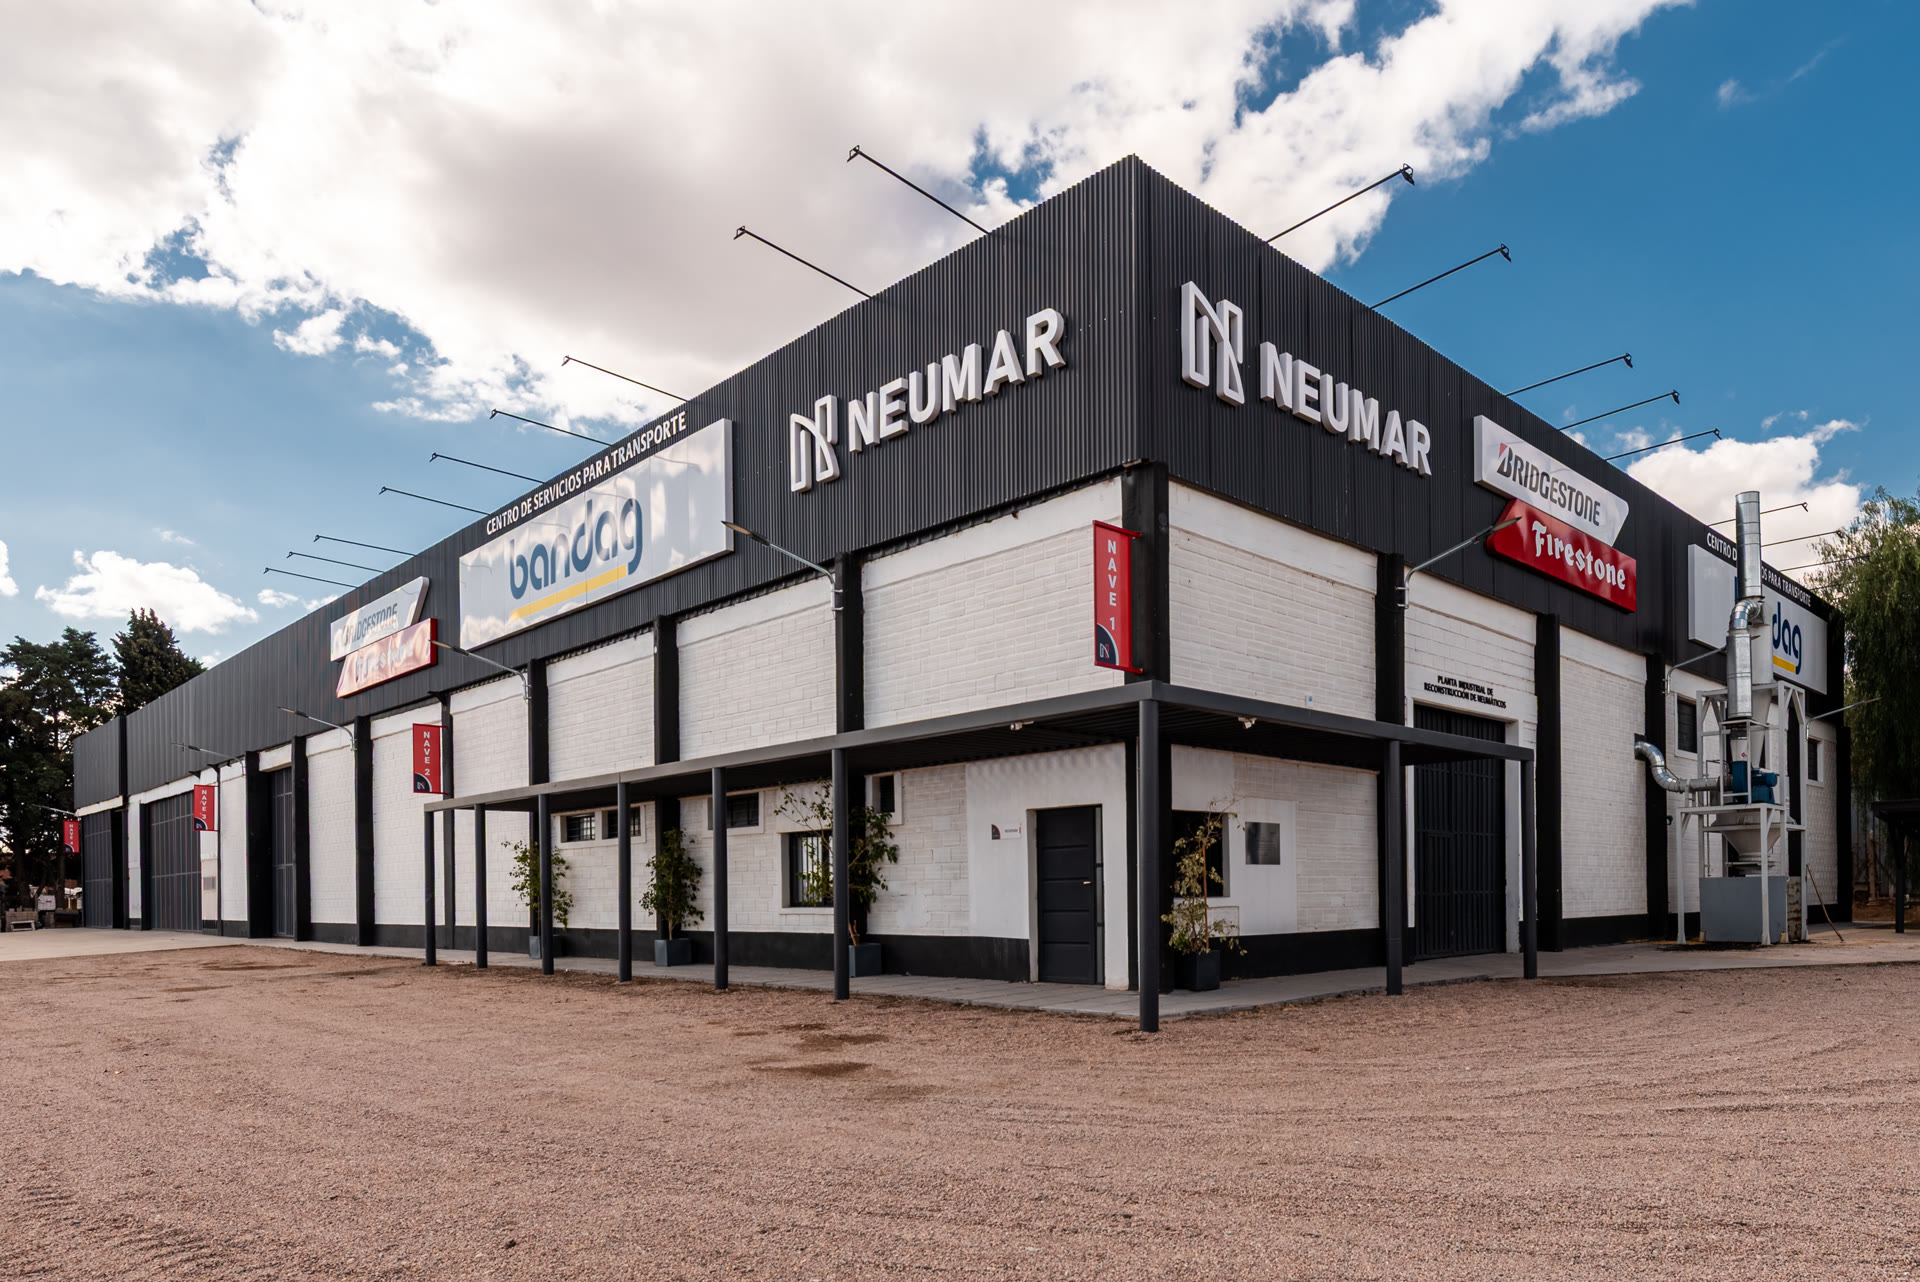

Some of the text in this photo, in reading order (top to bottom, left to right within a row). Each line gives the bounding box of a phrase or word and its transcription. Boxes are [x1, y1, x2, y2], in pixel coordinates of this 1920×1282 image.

[848, 308, 1066, 454] NEUMAR
[1260, 341, 1432, 476] NEUMAR
[486, 410, 687, 535] CENTRO DE SERVICIOS PARA TRANSPORTE
[1496, 442, 1601, 527] BRIDGESTONE
[509, 497, 643, 600] bandag
[1107, 539, 1117, 631] NAVE 1
[1531, 520, 1626, 590] Firestone
[1706, 532, 1731, 559] CENTRO
[1731, 547, 1737, 561] D
[1768, 570, 1781, 588] PARA
[342, 603, 398, 647] BRIDGESTONE
[1772, 601, 1802, 675] dag
[1424, 682, 1507, 709] RECONSTRUCCIÓN DE NEUMÁTICOS
[1437, 674, 1494, 697] PLANTA INDUSTRIAL DE
[423, 731, 431, 776] NAVE 2
